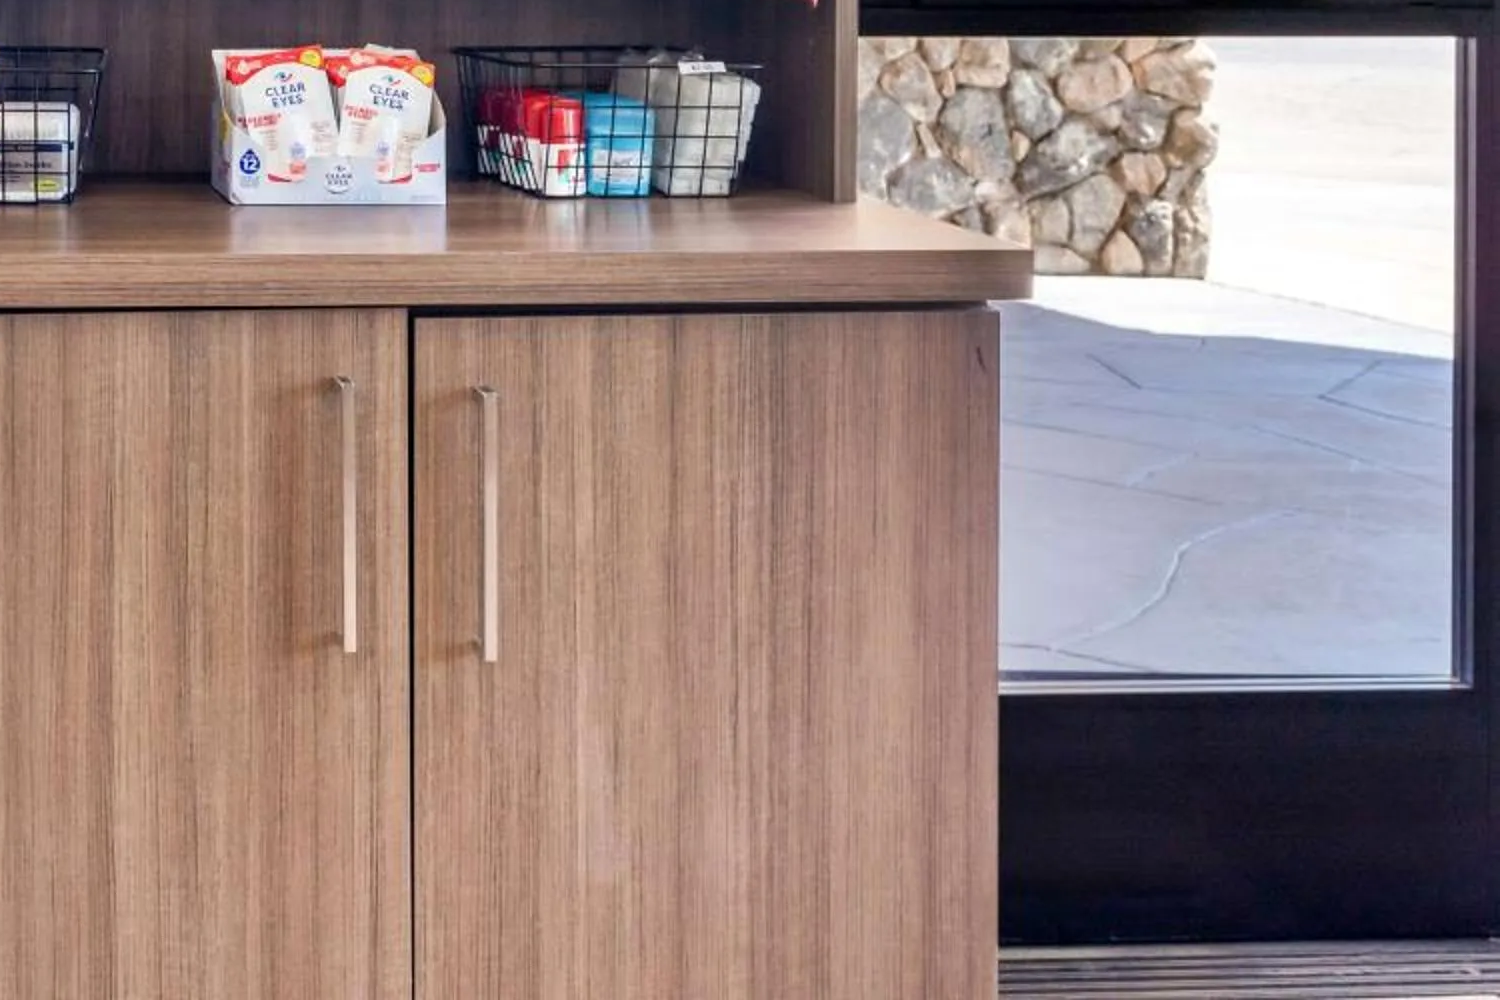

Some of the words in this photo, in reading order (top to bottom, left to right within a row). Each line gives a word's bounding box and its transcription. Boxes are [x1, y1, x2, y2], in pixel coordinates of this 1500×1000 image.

[265, 82, 306, 97] CLEAR
[369, 83, 410, 100] CLEAR
[272, 94, 304, 108] EYES
[373, 95, 404, 110] EYES
